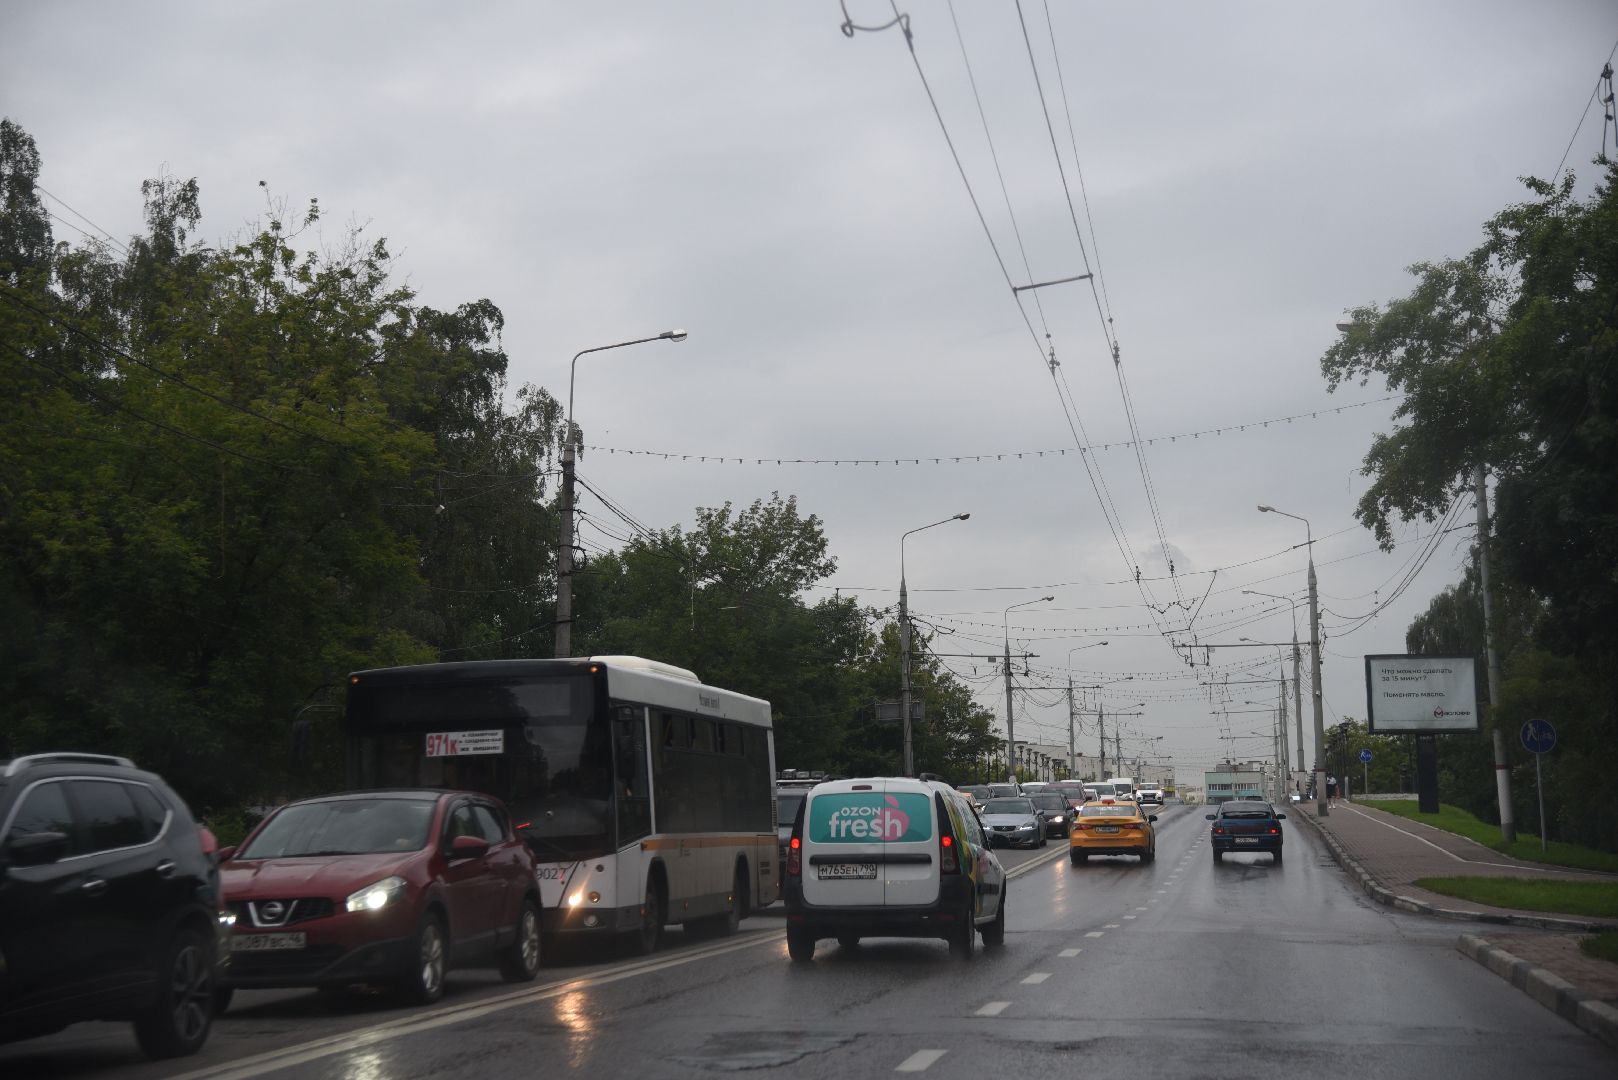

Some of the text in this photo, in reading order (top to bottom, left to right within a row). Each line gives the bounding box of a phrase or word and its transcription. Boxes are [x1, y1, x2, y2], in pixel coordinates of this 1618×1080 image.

[840, 806, 881, 817] OZON
[828, 811, 902, 838] fresh
[860, 864, 875, 872] 790
